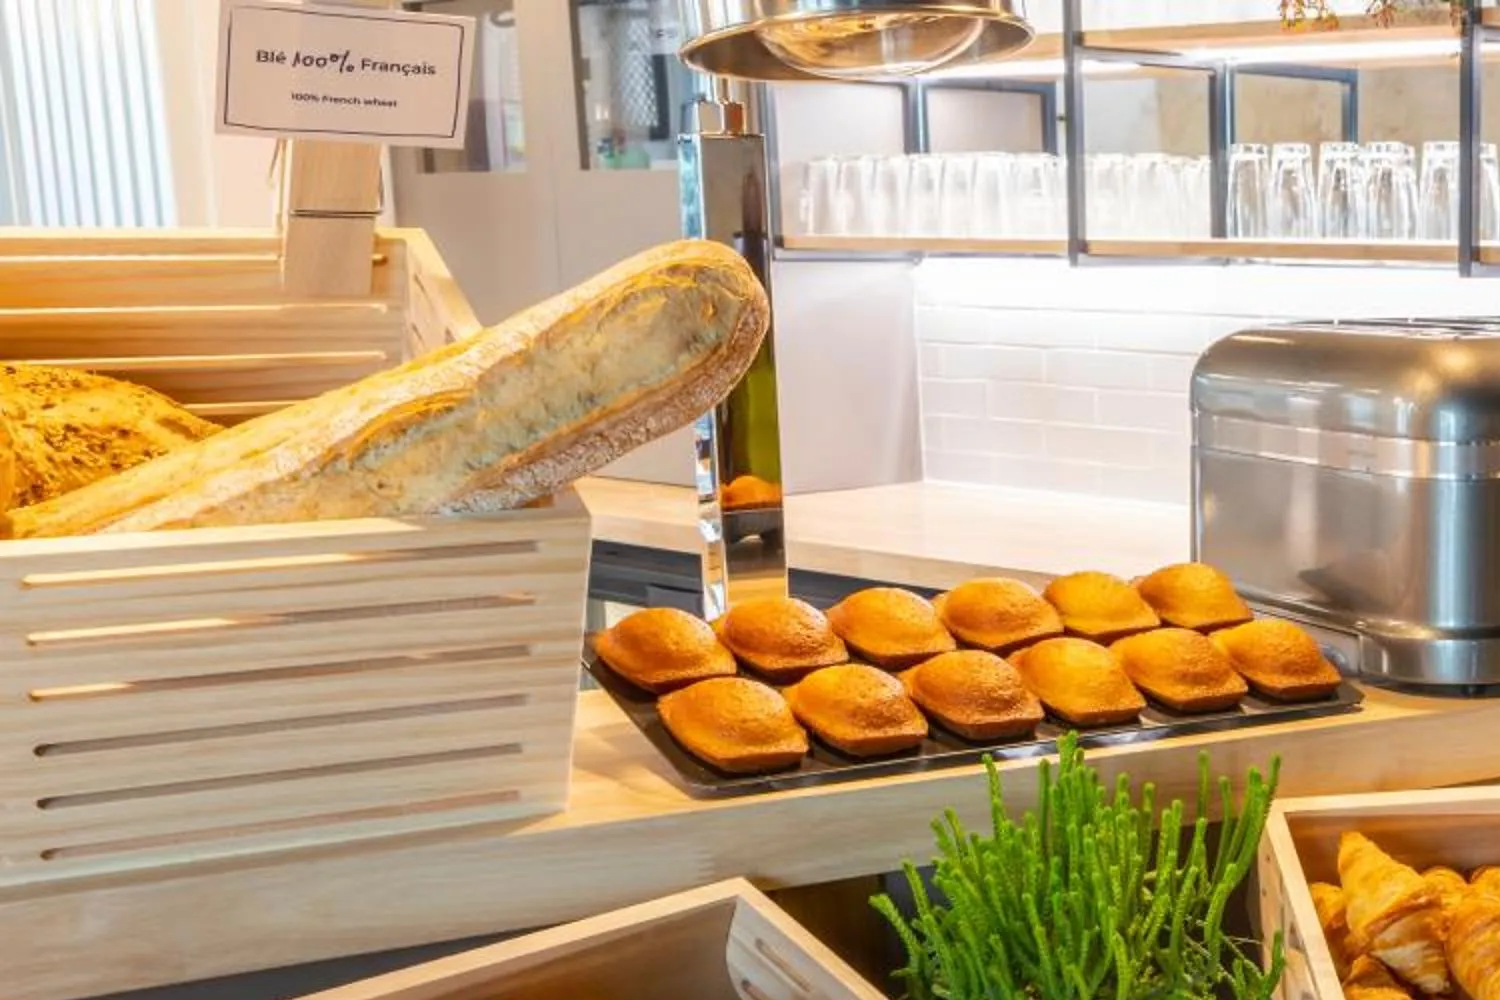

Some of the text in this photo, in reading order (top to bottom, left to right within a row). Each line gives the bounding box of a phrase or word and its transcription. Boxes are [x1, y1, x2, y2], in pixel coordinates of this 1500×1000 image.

[255, 49, 437, 77] Blé 100% Français
[291, 92, 397, 108] 100% French wheat
